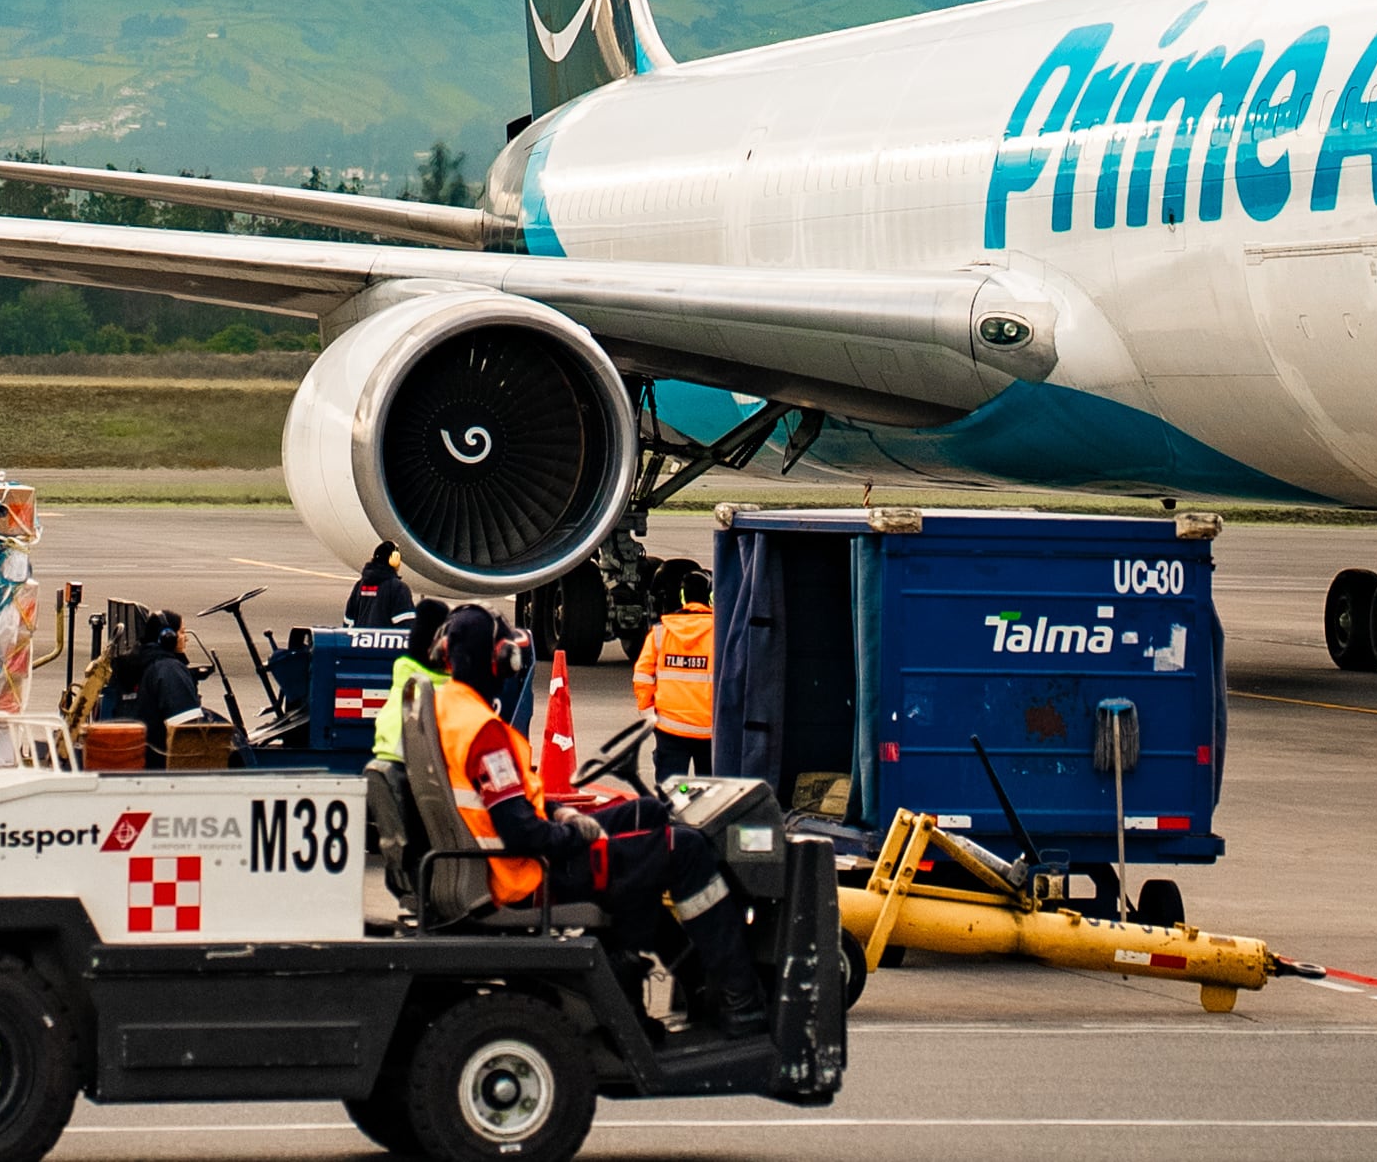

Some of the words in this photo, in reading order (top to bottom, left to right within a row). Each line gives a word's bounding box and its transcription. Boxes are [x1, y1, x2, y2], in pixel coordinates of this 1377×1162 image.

[984, 0, 1330, 249] Prime
[984, 611, 1114, 654] Talma
[151, 817, 243, 839] EMSA
[152, 843, 193, 851] AIRPORT
[250, 798, 350, 875] M38
